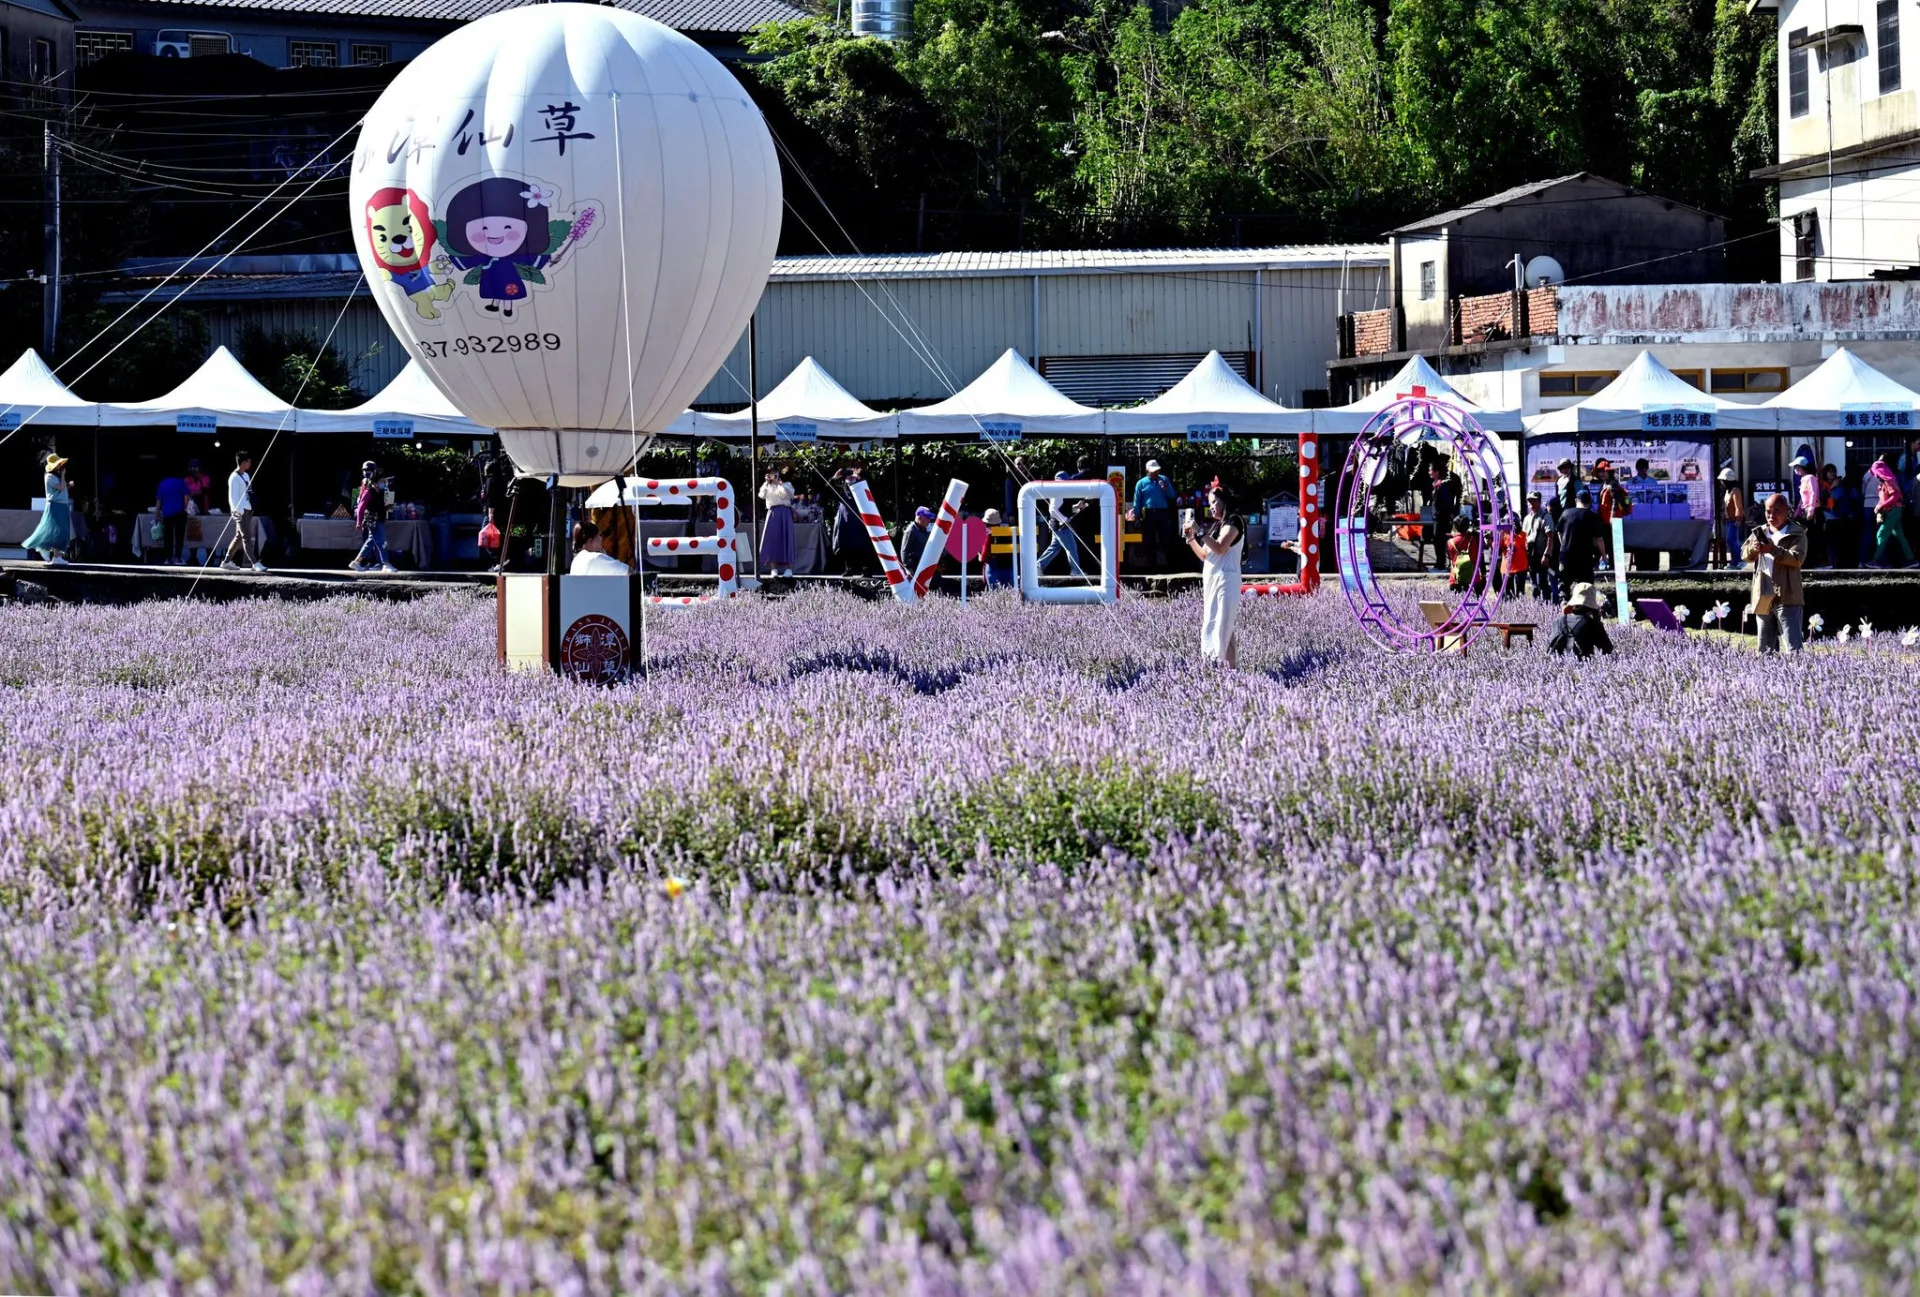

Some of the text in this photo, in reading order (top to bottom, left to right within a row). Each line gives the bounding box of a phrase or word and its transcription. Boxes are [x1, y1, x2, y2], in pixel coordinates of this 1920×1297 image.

[356, 101, 596, 173] 仙草
[416, 332, 562, 359] 37-932989
[1647, 413, 1712, 427] 地景投票處
